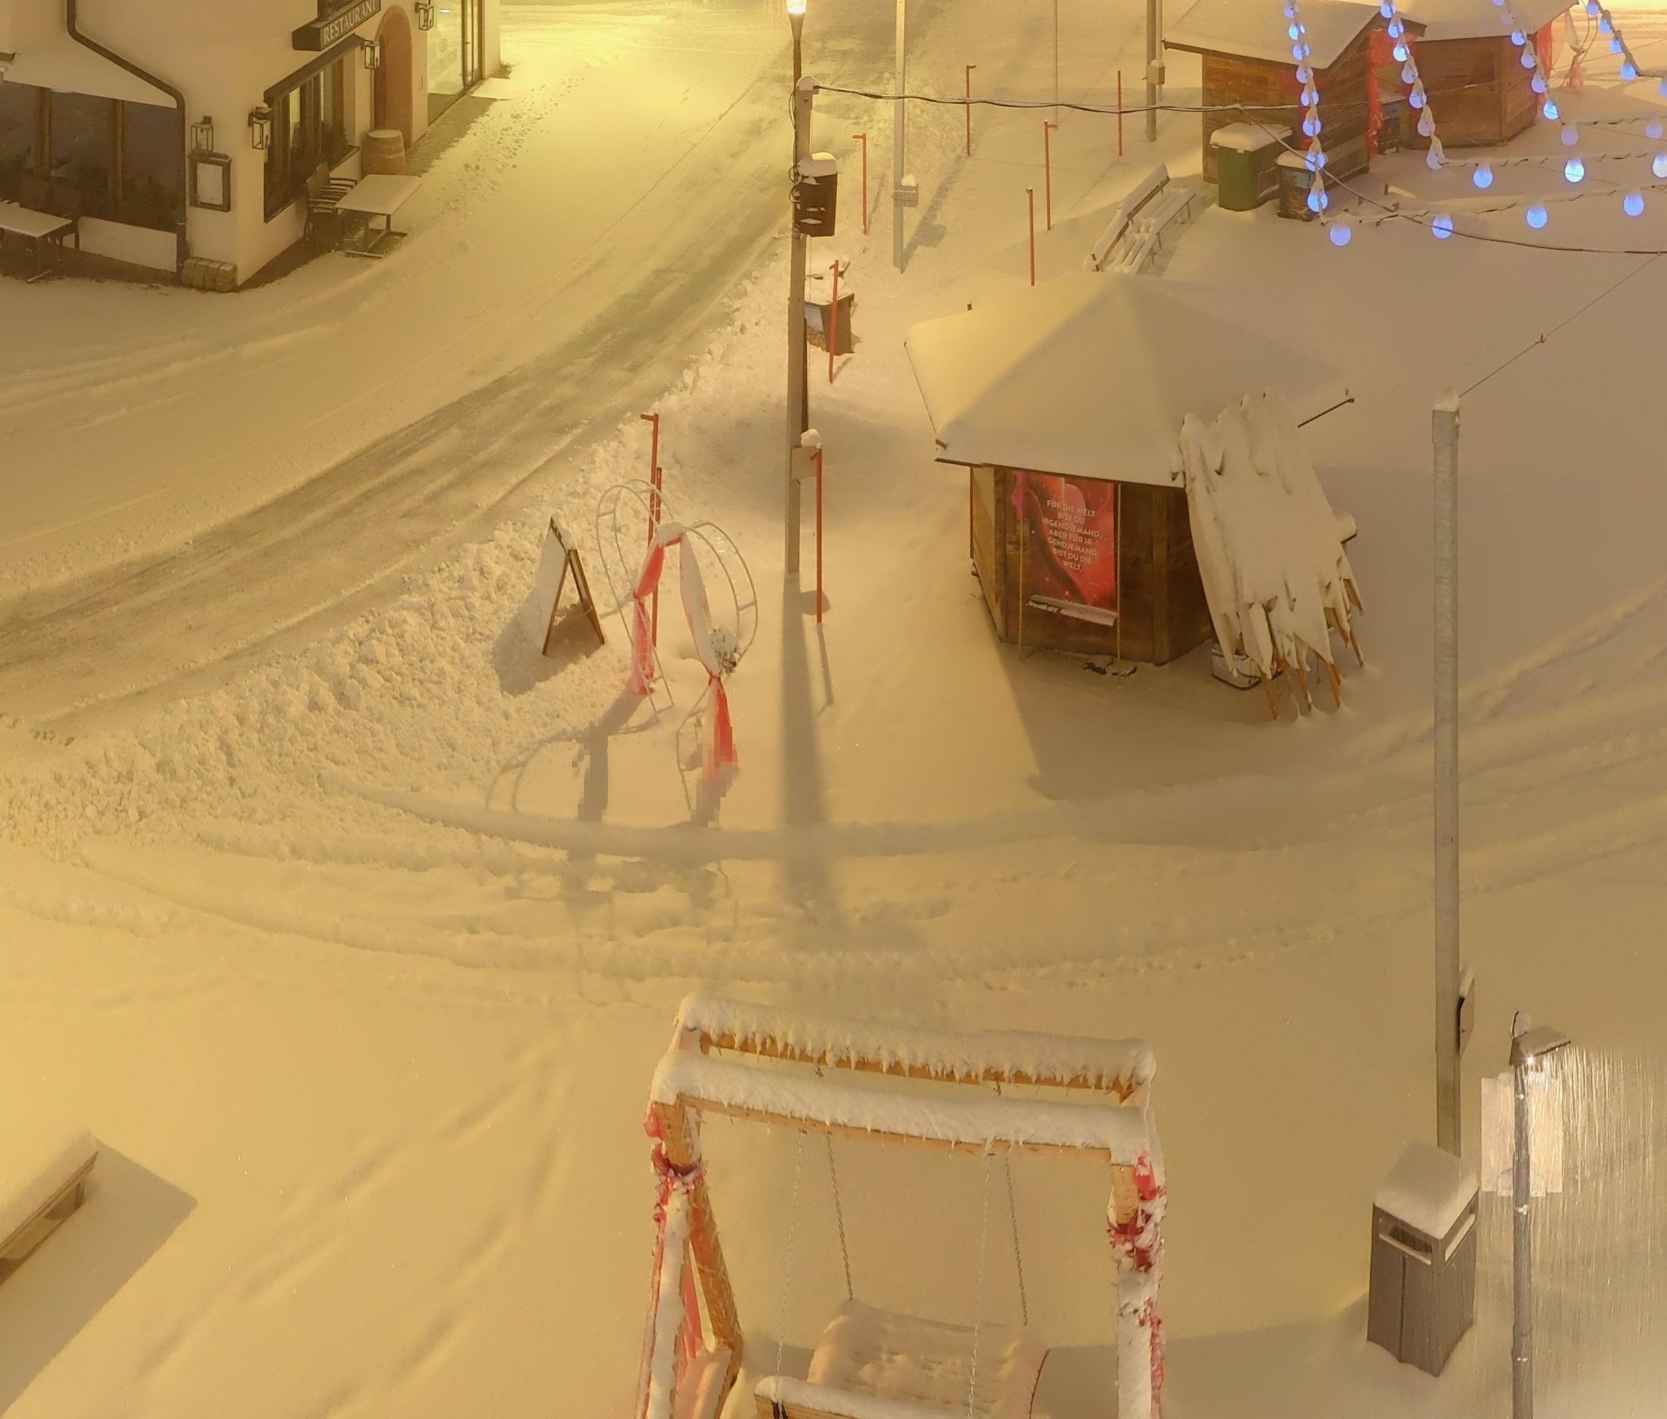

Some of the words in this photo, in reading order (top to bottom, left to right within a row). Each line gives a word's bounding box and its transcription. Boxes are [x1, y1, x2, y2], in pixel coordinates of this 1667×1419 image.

[1046, 499, 1061, 509] FÜR
[1063, 503, 1076, 513] DIE
[1077, 507, 1096, 517] WELT
[1058, 512, 1072, 522] BIST
[1073, 515, 1085, 525] DU
[1049, 529, 1067, 539] ABER
[1068, 532, 1083, 542] FÜR
[1047, 537, 1097, 557] GENDJEMAND
[1052, 547, 1067, 558] BIST
[1068, 551, 1079, 561] DU
[1080, 555, 1092, 565] DIE
